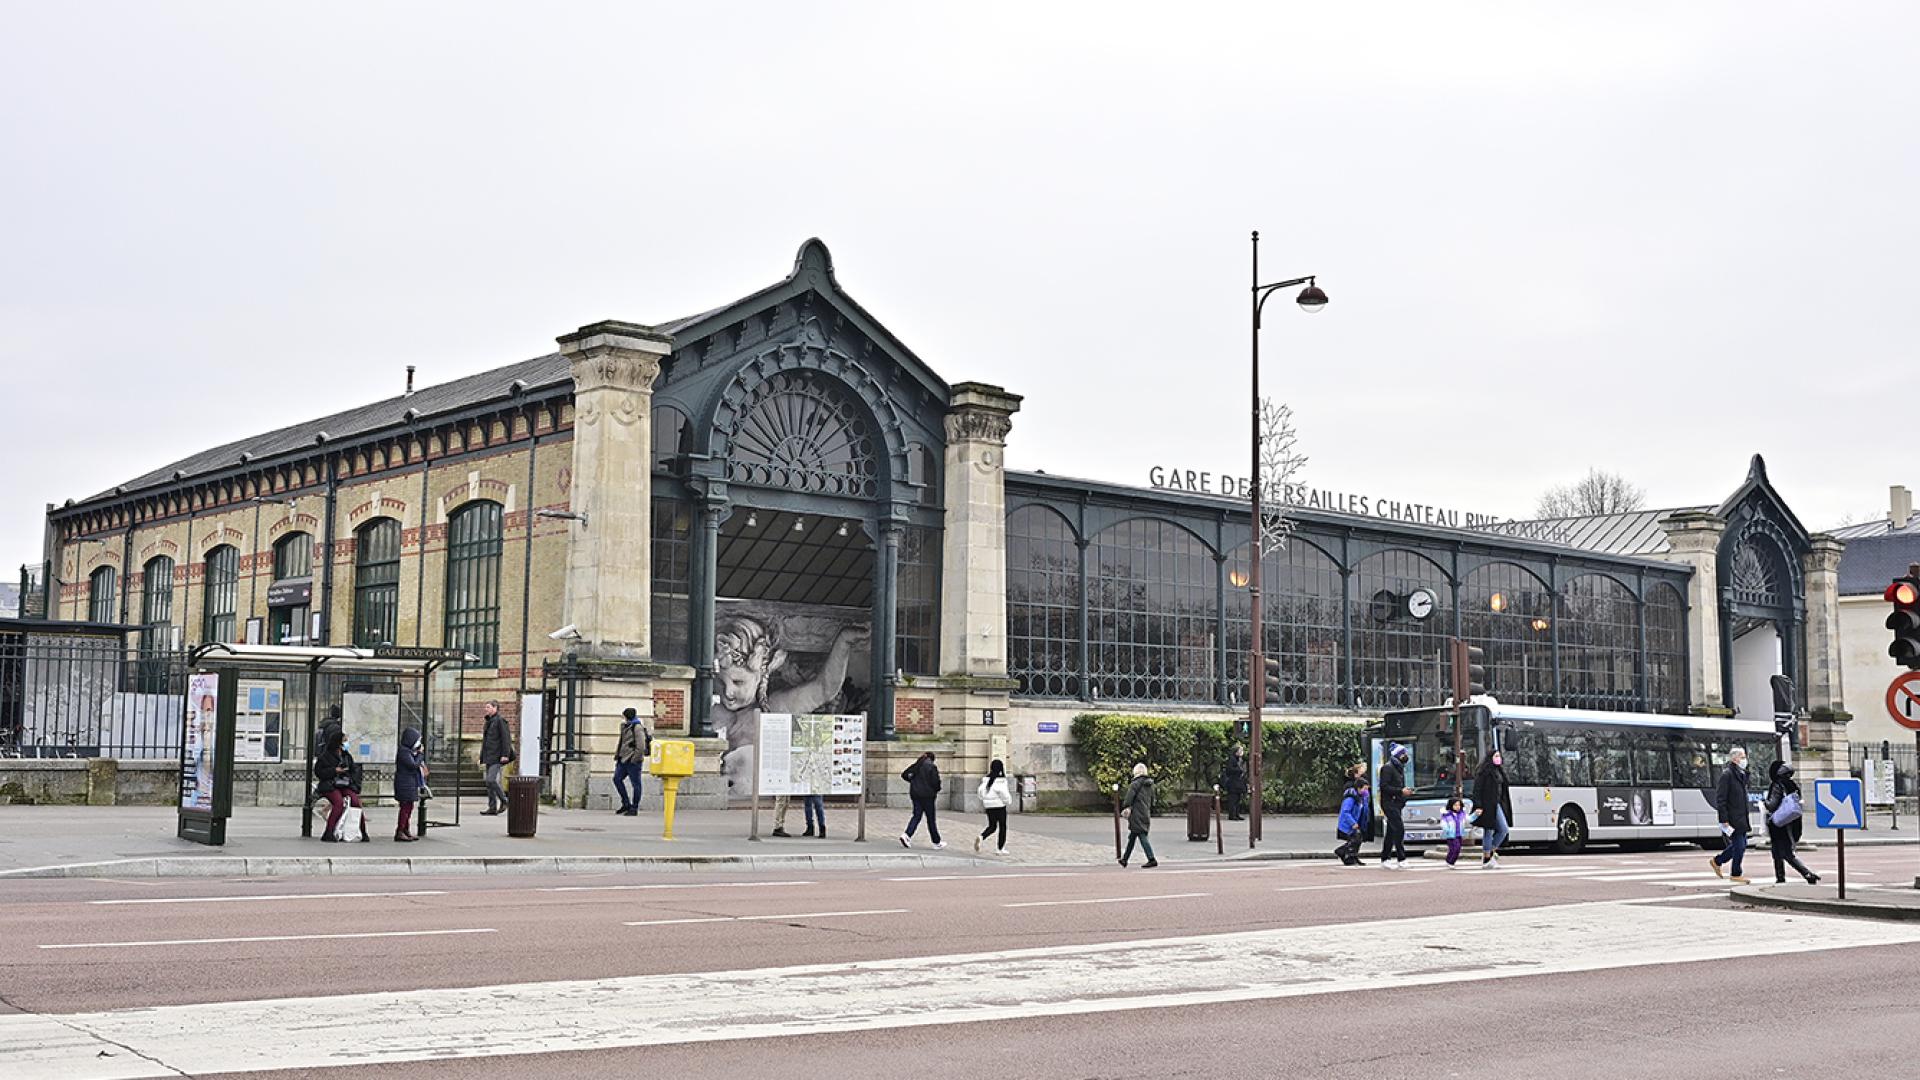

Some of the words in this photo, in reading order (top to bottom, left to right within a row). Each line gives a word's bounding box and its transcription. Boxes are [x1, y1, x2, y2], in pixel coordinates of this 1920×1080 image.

[1150, 466, 1211, 493] GARE
[1222, 475, 1250, 497] DE
[1377, 499, 1458, 528] CHATEAU
[1466, 512, 1499, 532] RIVE
[1506, 518, 1571, 543] GAUCHE
[378, 648, 402, 657] GARE
[404, 648, 424, 657] RIVE
